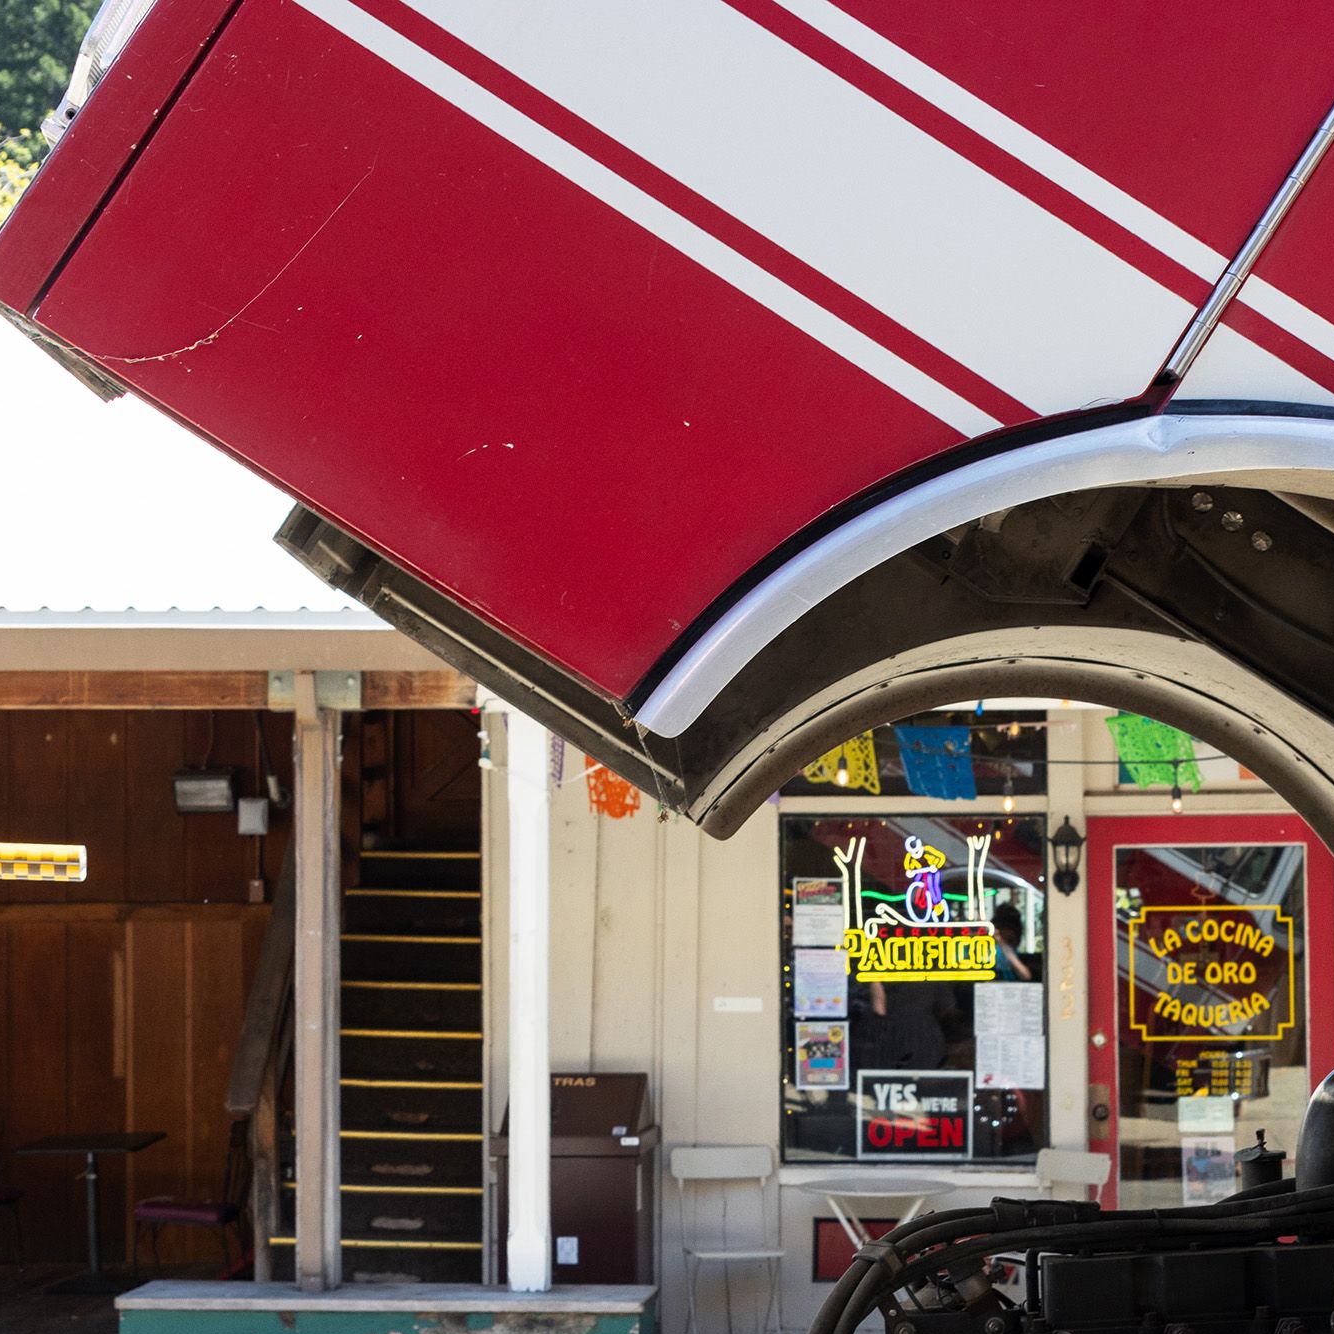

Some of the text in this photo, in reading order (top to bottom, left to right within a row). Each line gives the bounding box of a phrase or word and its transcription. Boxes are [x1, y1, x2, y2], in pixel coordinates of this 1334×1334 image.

[1148, 919, 1275, 958] LA COCINA
[1167, 961, 1257, 984] DE ORO
[1153, 991, 1271, 1027] TAQUERIA
[873, 1083, 957, 1112] YES WE'RE
[867, 1117, 964, 1147] OPEN
